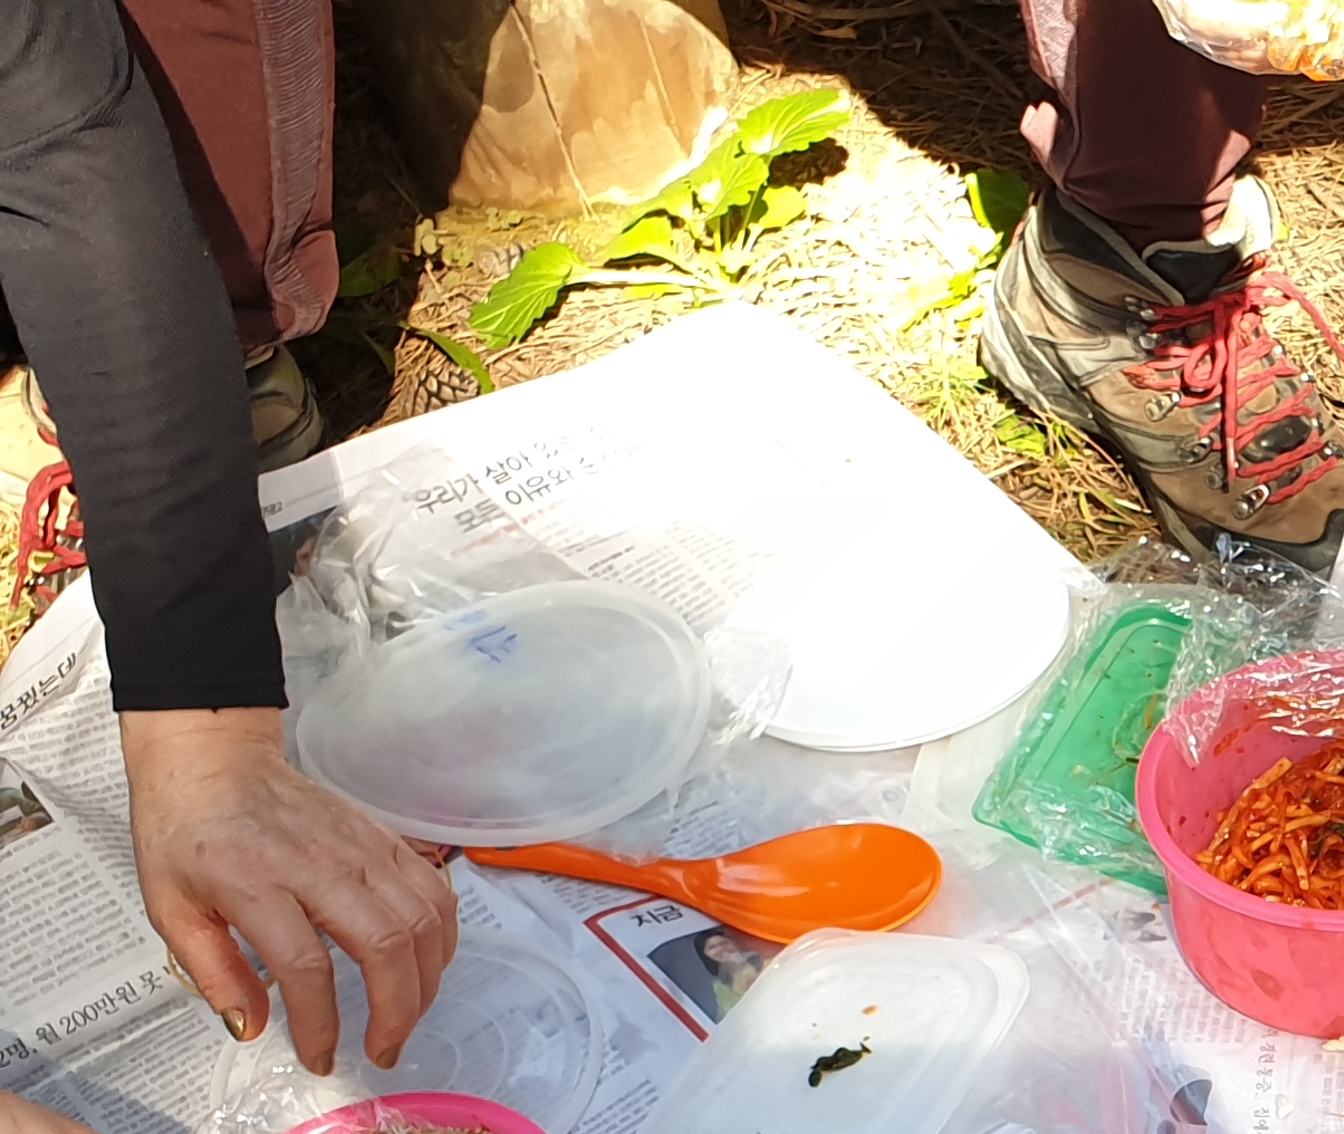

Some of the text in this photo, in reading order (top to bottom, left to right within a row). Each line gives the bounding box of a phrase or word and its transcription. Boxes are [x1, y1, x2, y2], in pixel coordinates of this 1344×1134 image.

[409, 472, 483, 512] 우리가
[486, 452, 533, 485] 살아
[506, 471, 575, 504] 이유와
[628, 903, 686, 929] 지금
[38, 1024, 58, 1040] 월
[60, 982, 141, 1034] 200만원
[140, 971, 163, 994] 못
